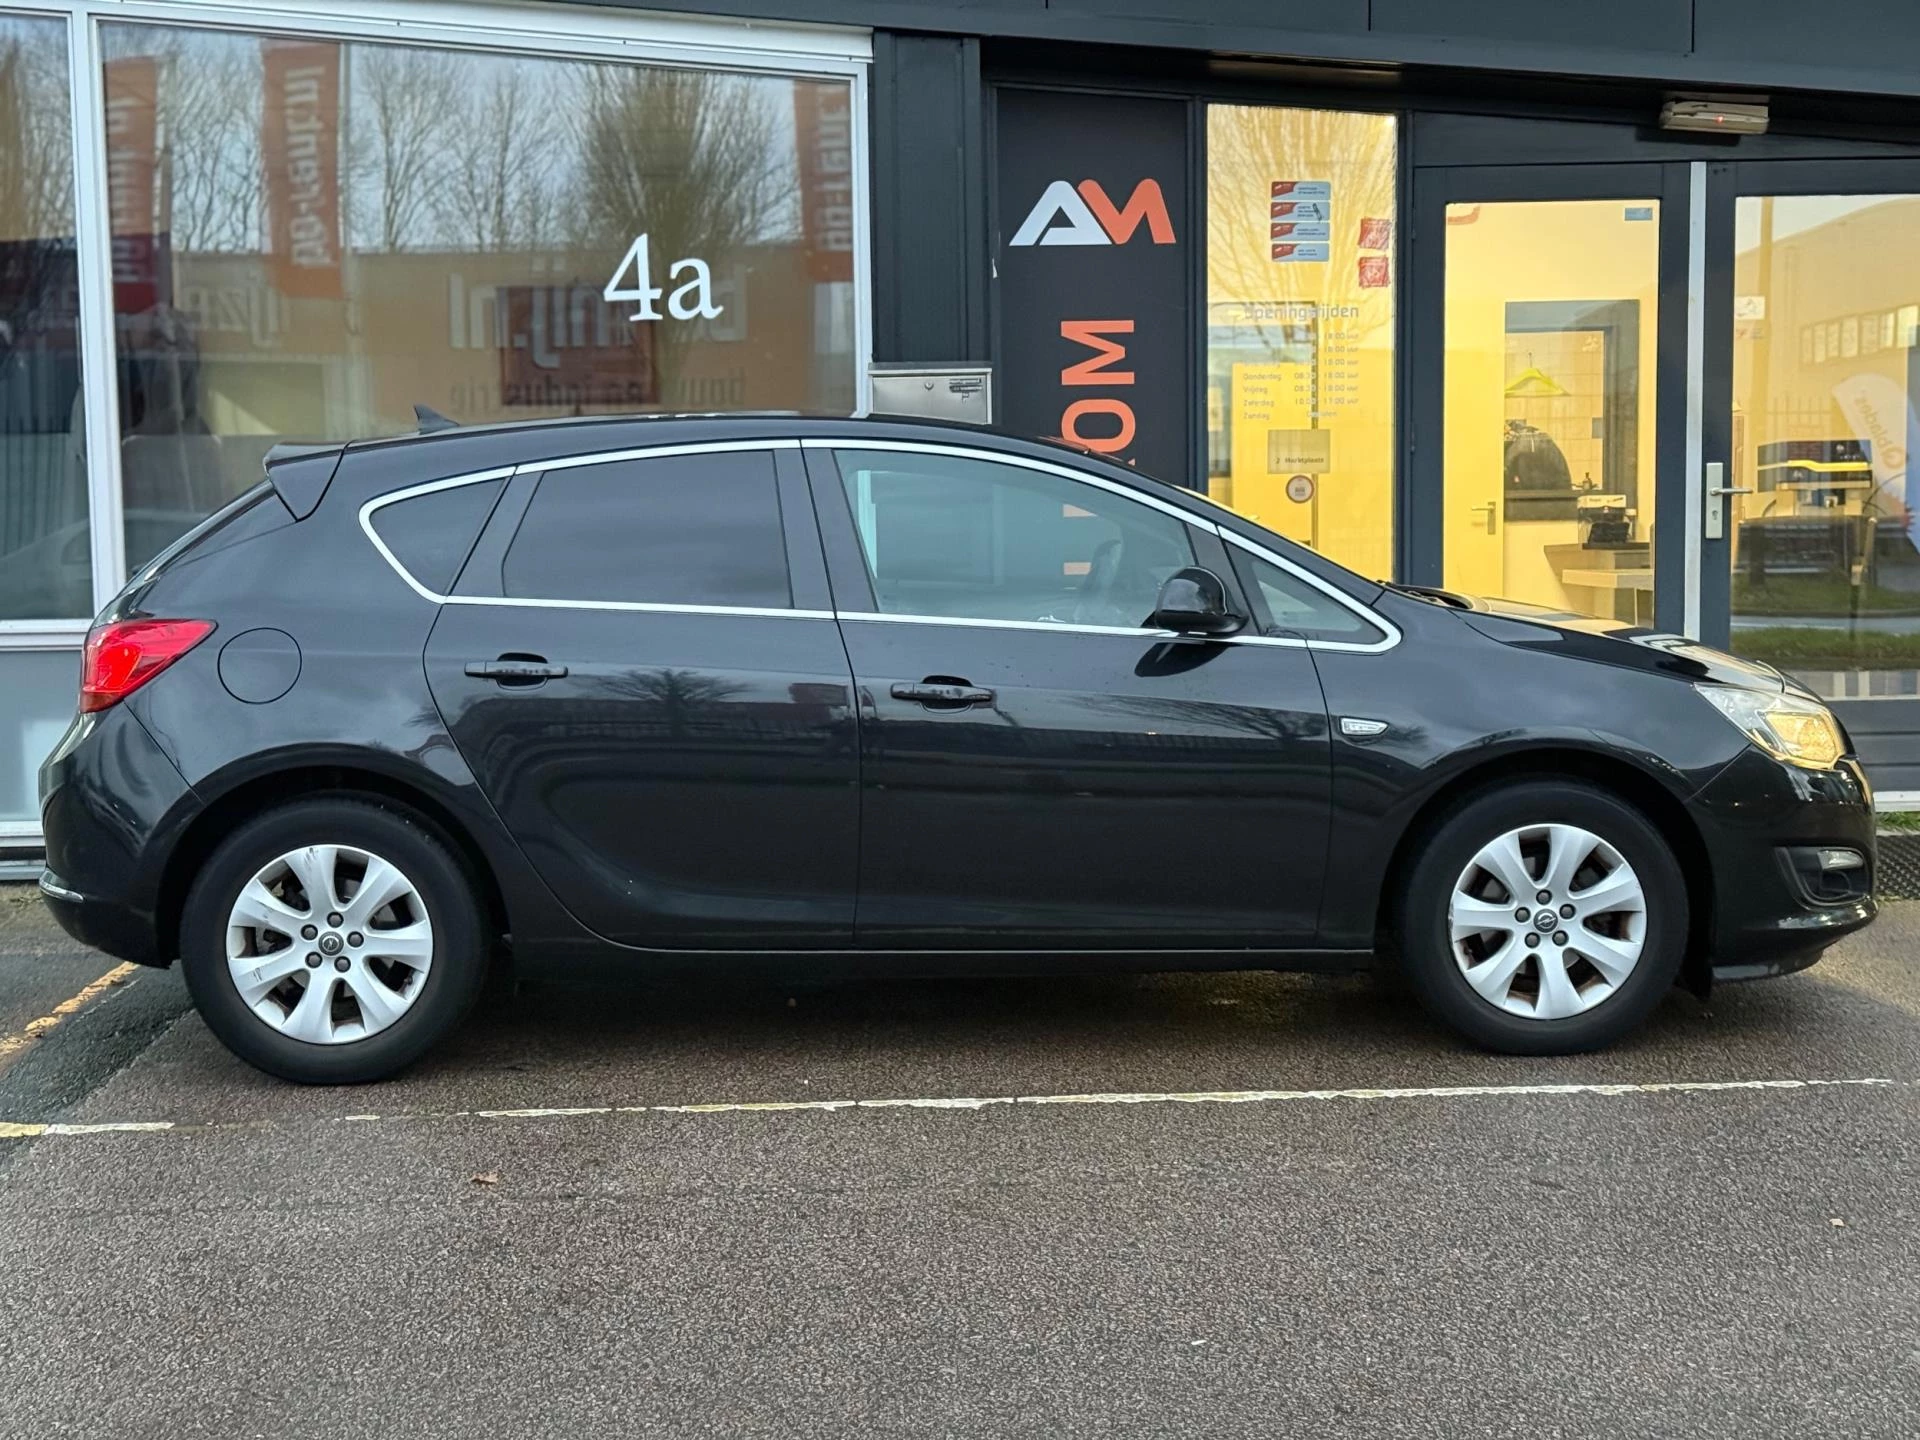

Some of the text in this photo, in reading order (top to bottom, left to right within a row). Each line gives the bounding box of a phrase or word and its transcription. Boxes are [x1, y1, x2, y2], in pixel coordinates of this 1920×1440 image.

[1009, 178, 1177, 246] AM
[603, 232, 723, 322] 4a
[1061, 320, 1136, 466] OM
